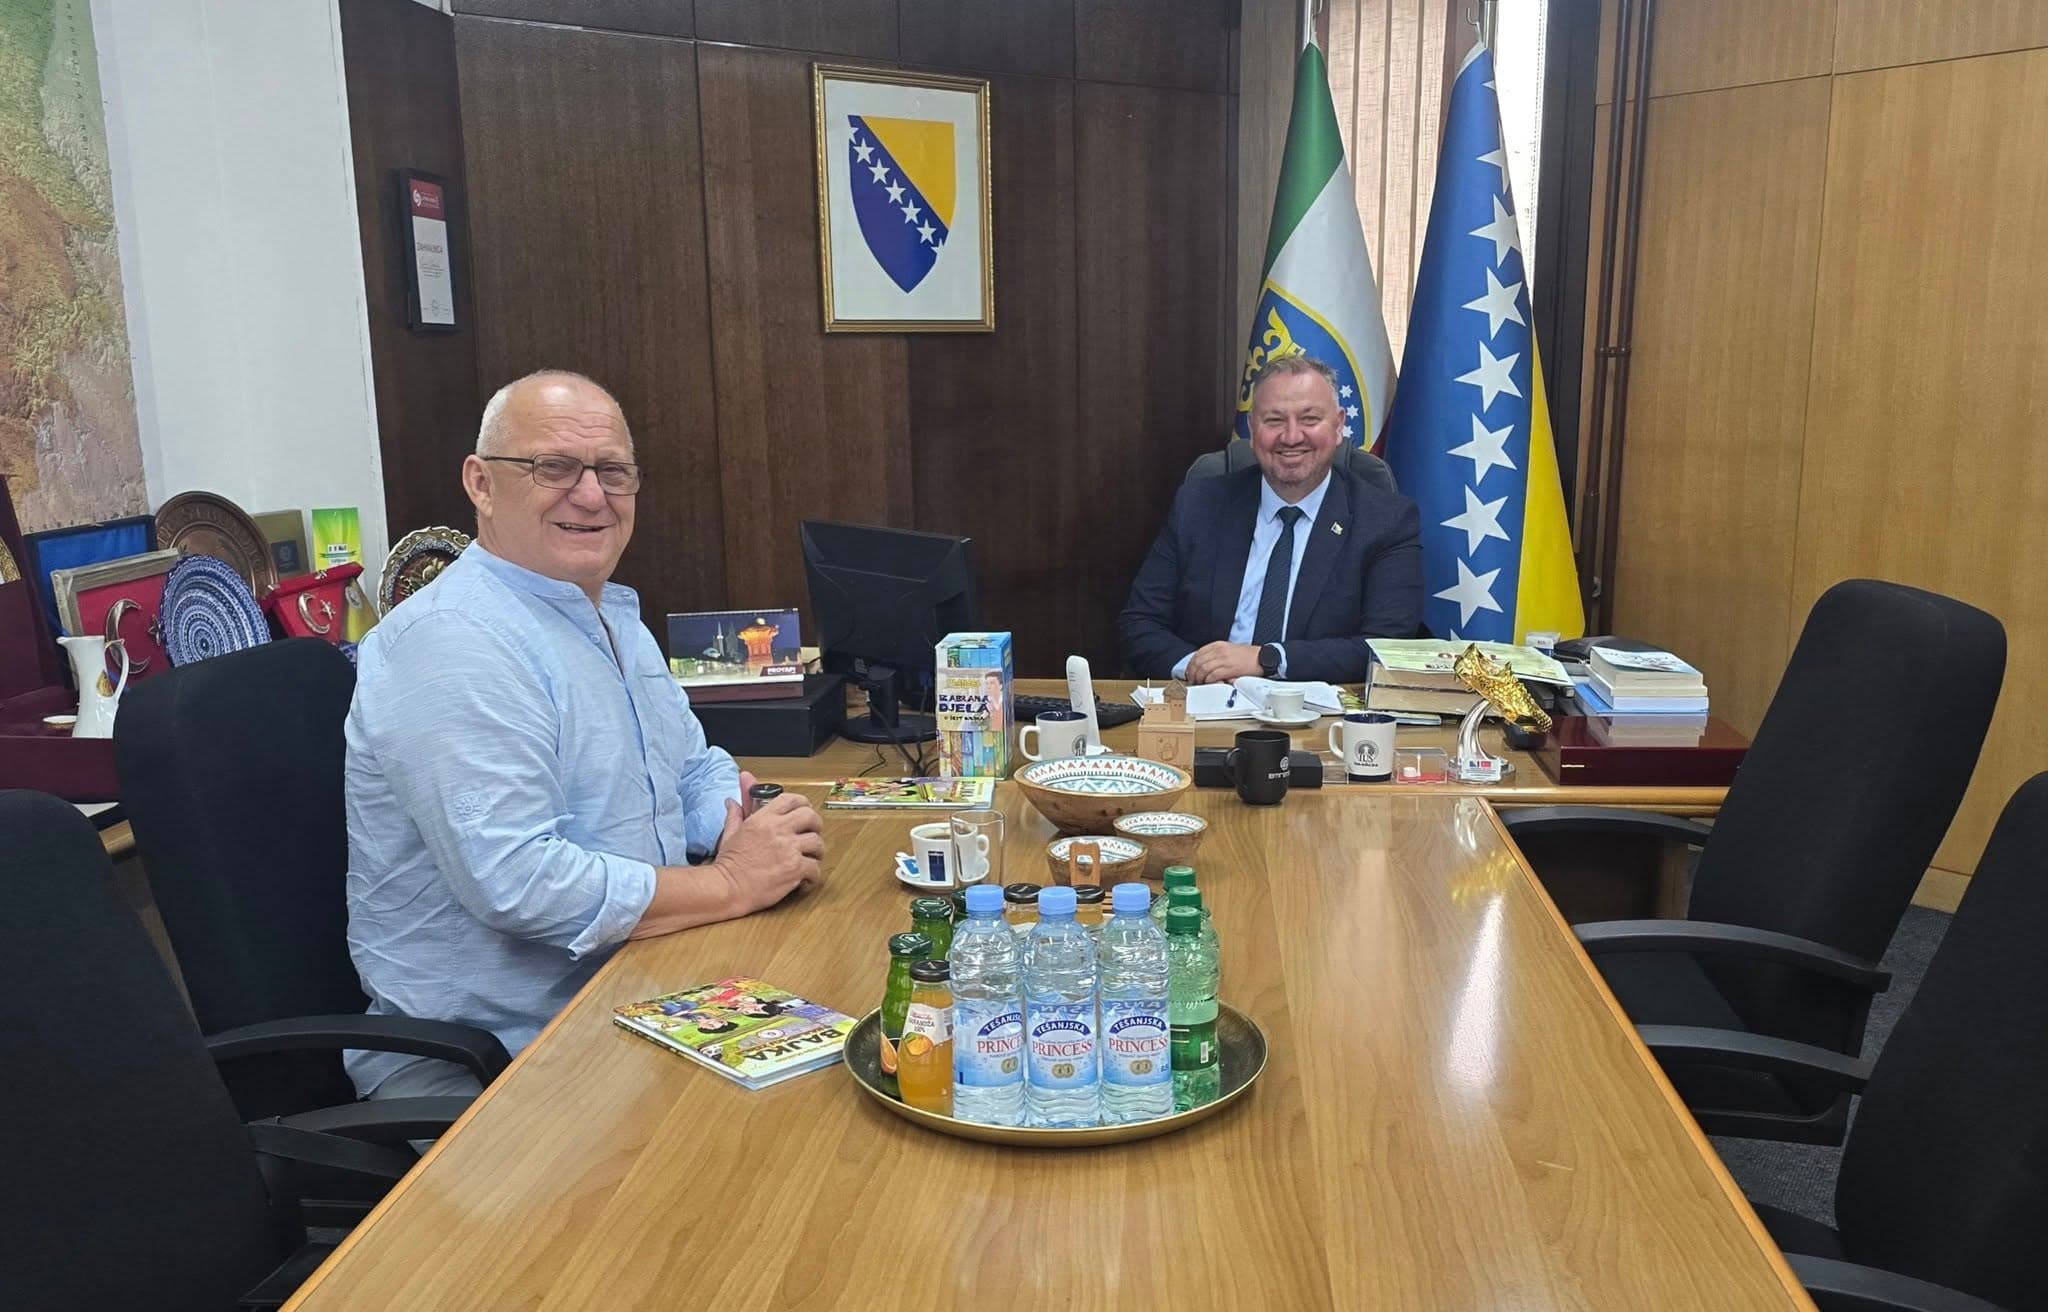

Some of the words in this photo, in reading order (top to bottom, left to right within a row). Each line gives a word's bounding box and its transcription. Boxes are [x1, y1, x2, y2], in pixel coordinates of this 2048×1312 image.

[939, 703, 989, 713] DJELA
[1037, 1021, 1086, 1035] TEŠANJSKA
[1114, 1017, 1165, 1032] TEŠANJSKA
[744, 1028, 845, 1060] BAJKA
[1032, 1039, 1093, 1057] PRINCESS
